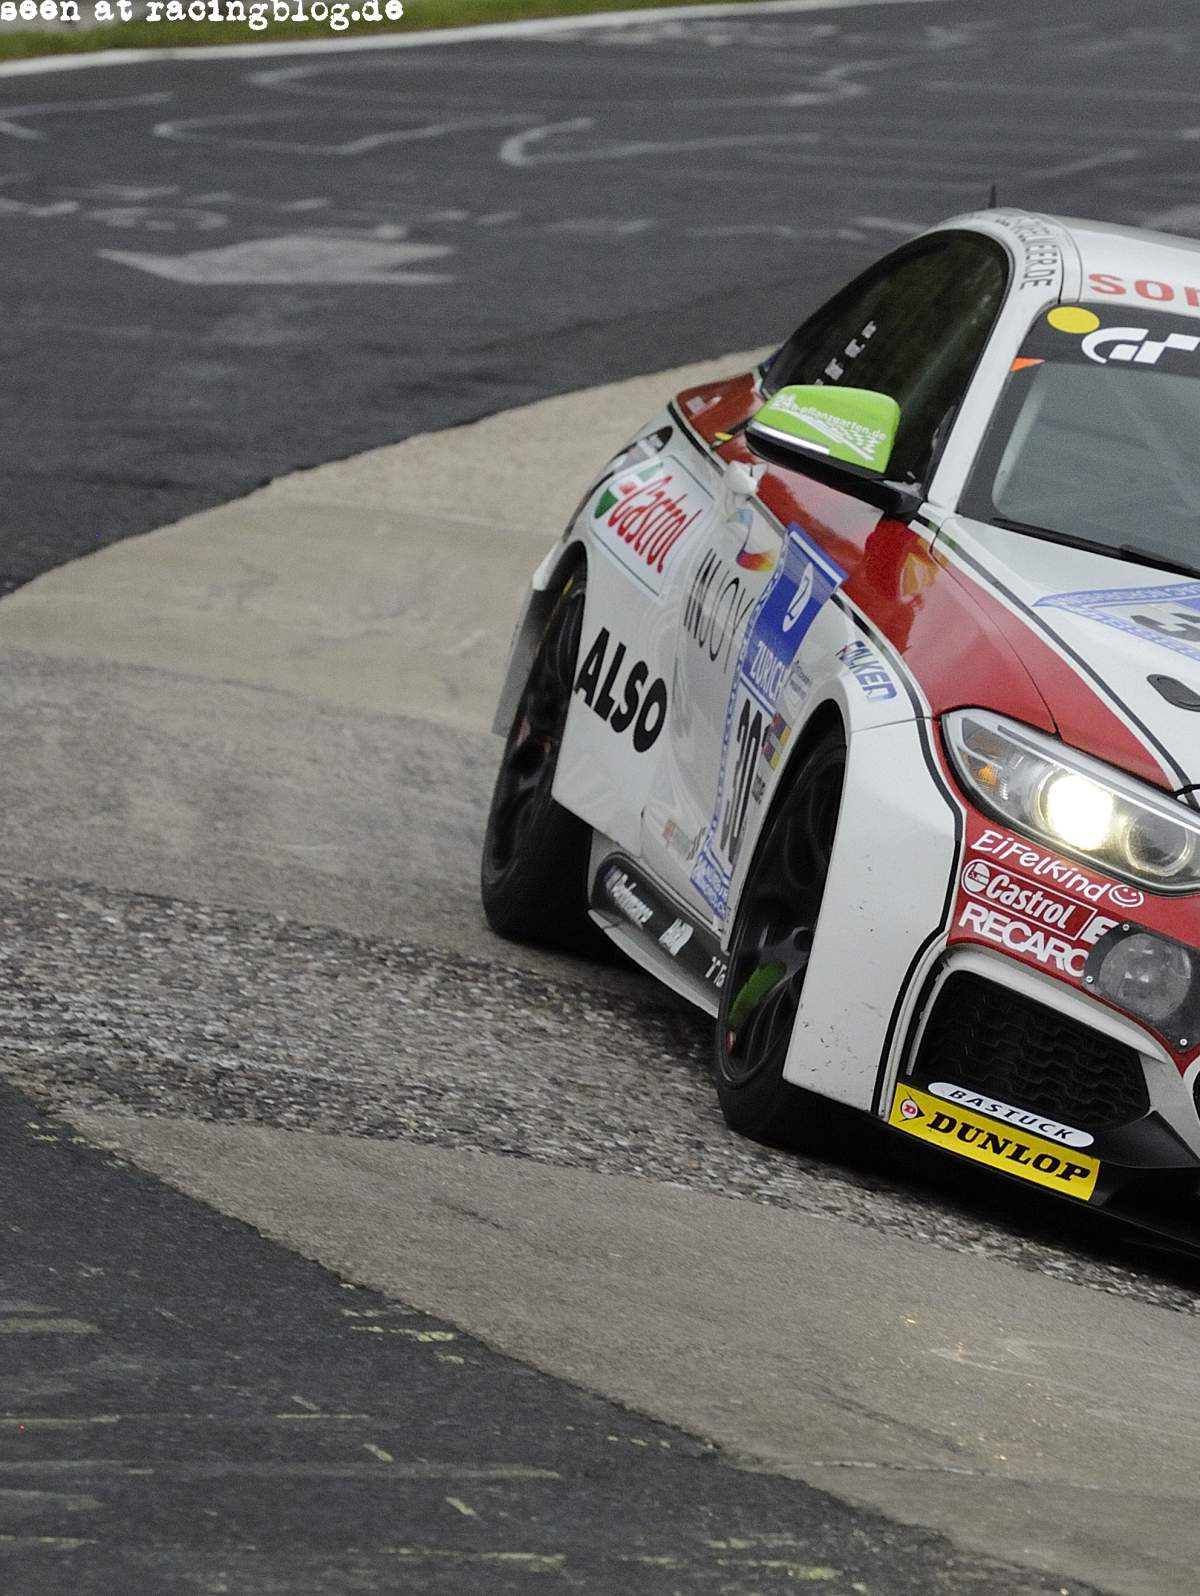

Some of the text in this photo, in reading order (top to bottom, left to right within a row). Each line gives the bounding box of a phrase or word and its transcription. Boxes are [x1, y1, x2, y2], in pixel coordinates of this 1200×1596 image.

[607, 475, 702, 574] Castrol
[573, 626, 668, 753] ALSO
[985, 870, 1077, 931] Castrol
[926, 1111, 1091, 1182] DUNLOP
[948, 1089, 1074, 1141] BASTUCK
